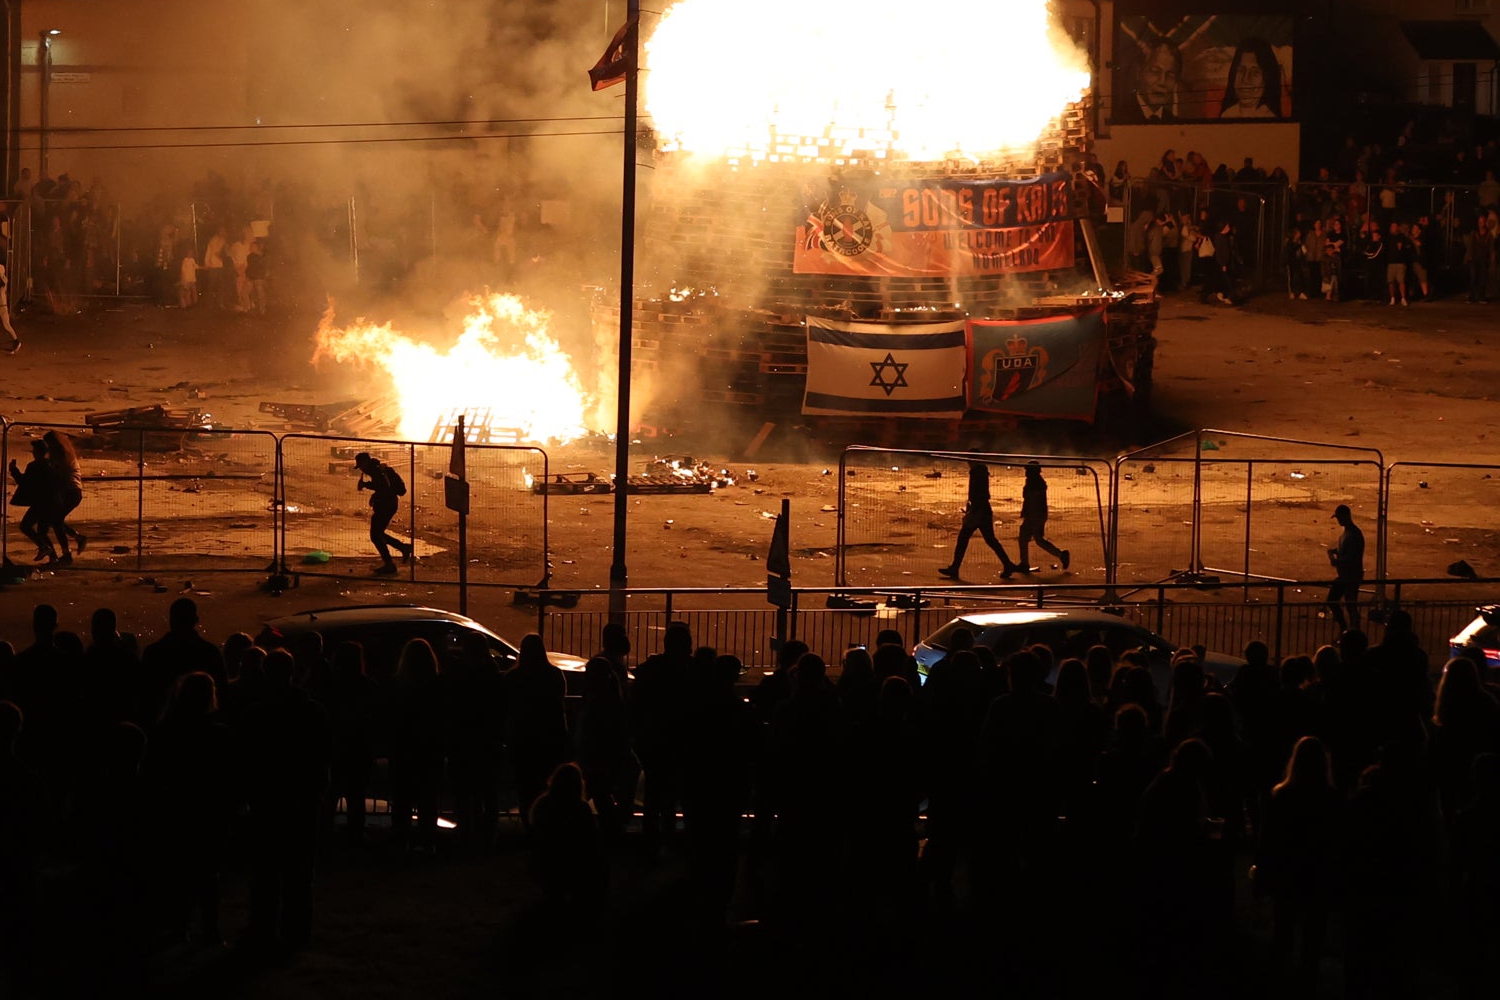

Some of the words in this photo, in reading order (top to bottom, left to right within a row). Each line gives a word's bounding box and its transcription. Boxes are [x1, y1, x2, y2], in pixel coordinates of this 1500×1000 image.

[903, 188, 974, 227] SONS
[983, 187, 1010, 225] OF
[1016, 184, 1048, 222] KAI
[944, 230, 1011, 249] WELCOME
[973, 248, 1039, 269] HOMELAND
[1002, 358, 1032, 369] UDA
